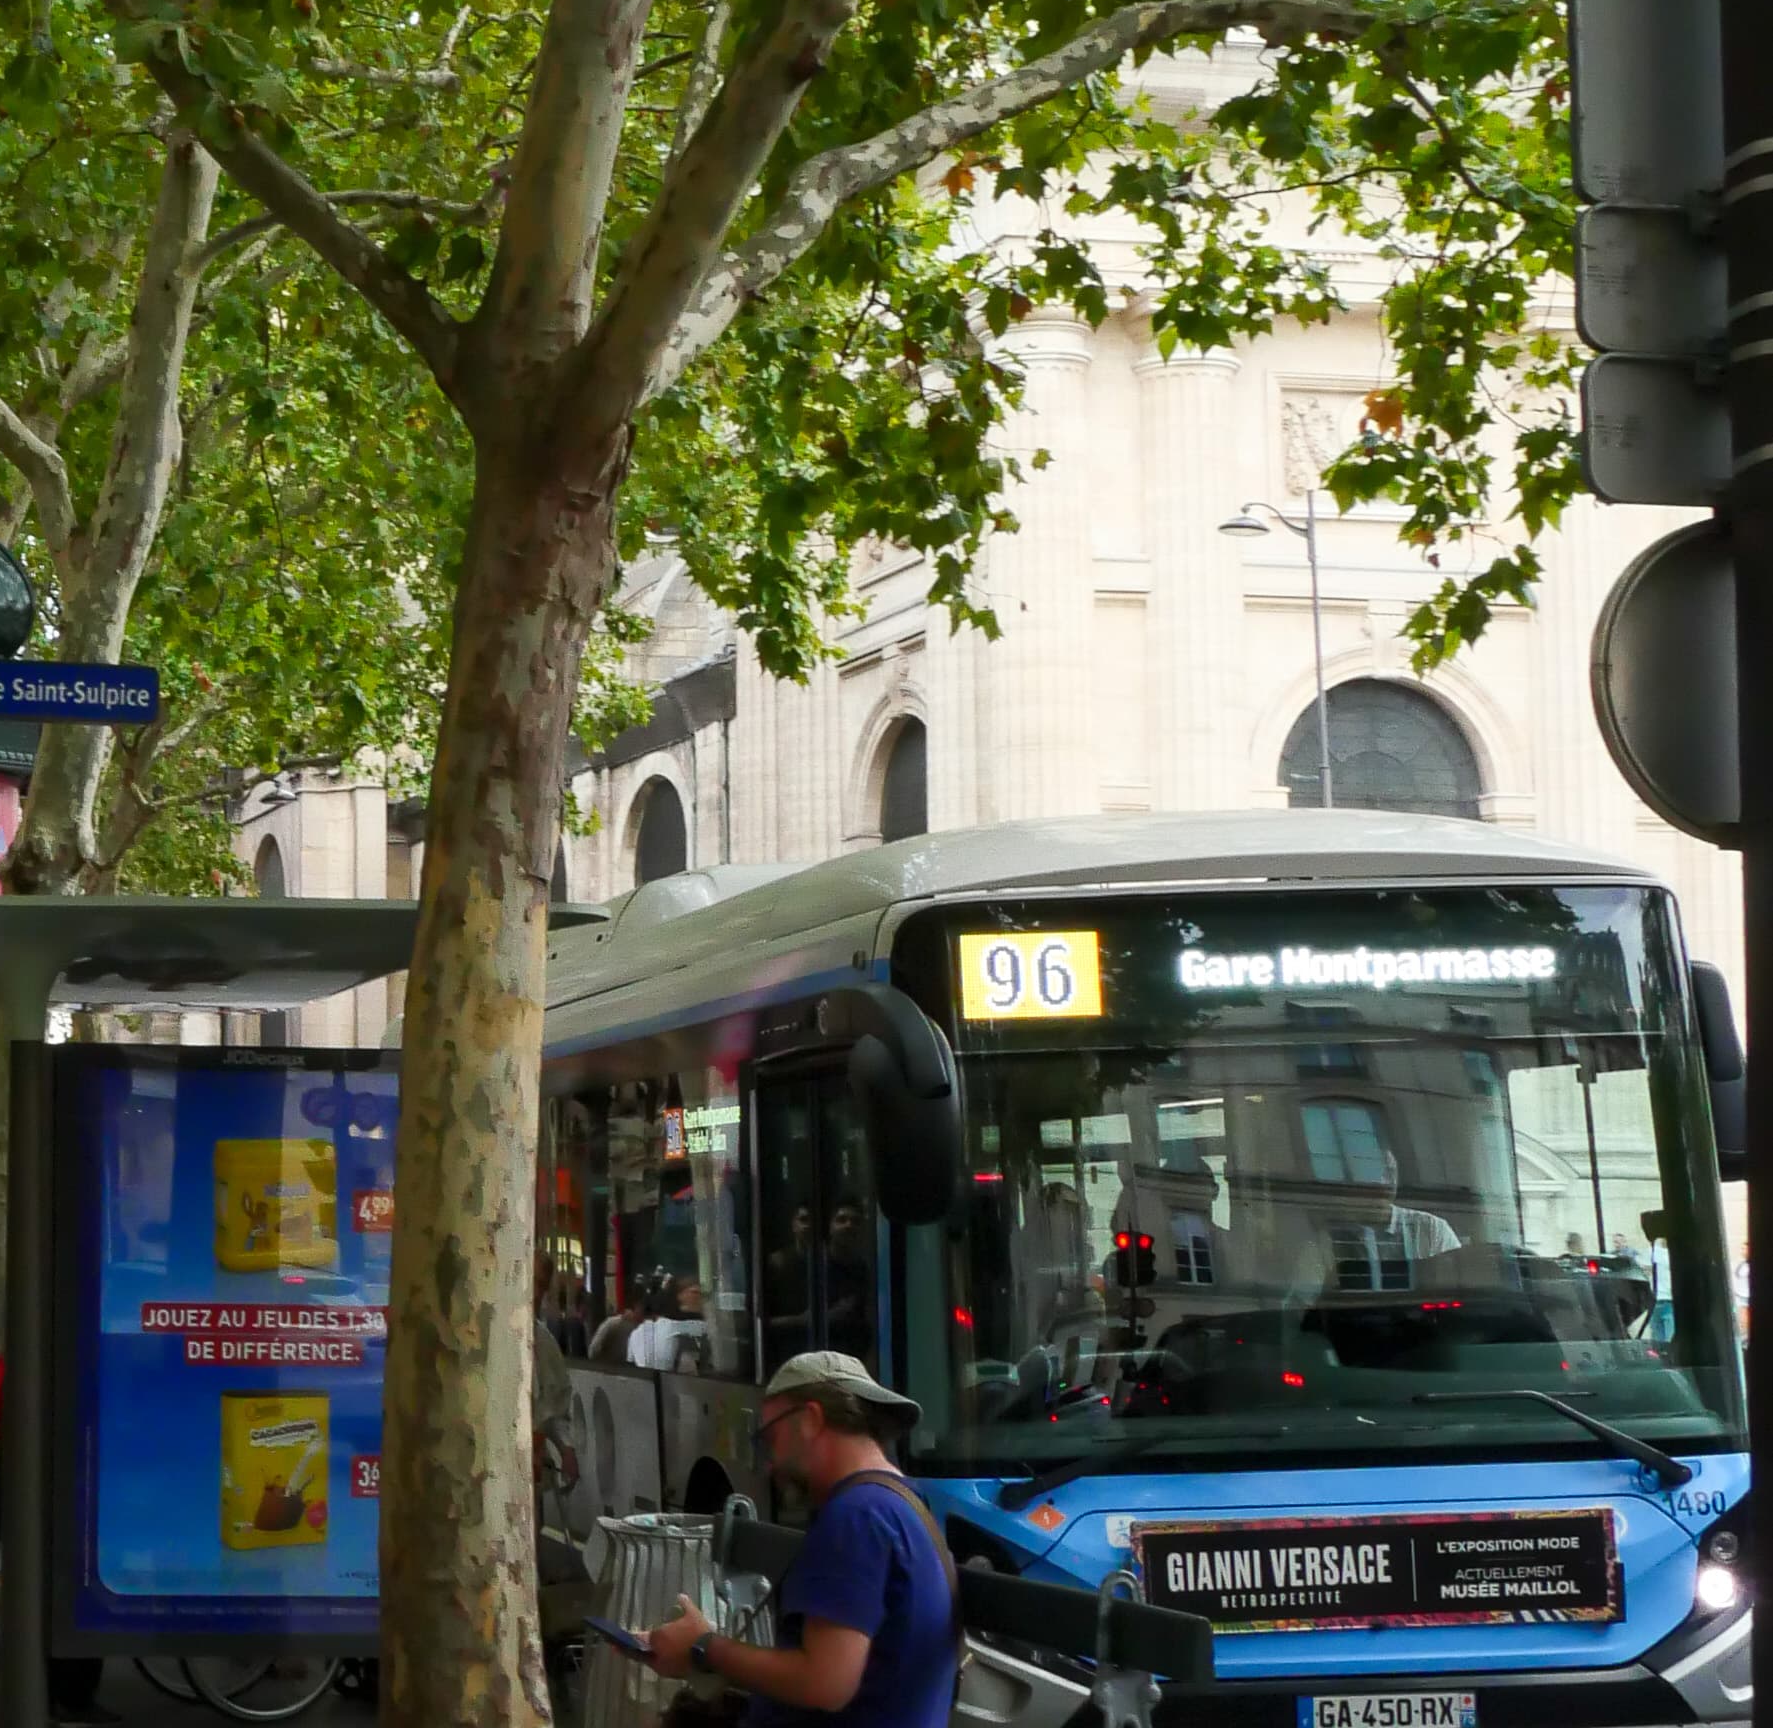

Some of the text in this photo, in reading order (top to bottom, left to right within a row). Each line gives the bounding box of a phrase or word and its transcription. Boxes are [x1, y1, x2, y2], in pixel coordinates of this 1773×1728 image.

[12, 678, 150, 710] Saint-Sulpice
[986, 945, 1072, 1006] 96
[1178, 945, 1556, 989] Gare Montparnasse
[144, 1309, 212, 1327] JOUEZ
[218, 1310, 246, 1327] AU
[252, 1310, 292, 1328] JEU
[298, 1311, 339, 1329] DES
[187, 1338, 360, 1361] DE DIFFÉRENCE.
[1663, 1490, 1726, 1517] 1480
[1436, 1536, 1580, 1554] L'EXPOSITION MODE
[1167, 1544, 1393, 1592] GIANNI VERSACE
[1455, 1565, 1565, 1581] ACTUELLEMENT
[1221, 1590, 1342, 1609] RETROSPECTIVE
[1440, 1580, 1581, 1599] MUSÉE MAILLOL
[1319, 1697, 1454, 1728] GA-450-RX
